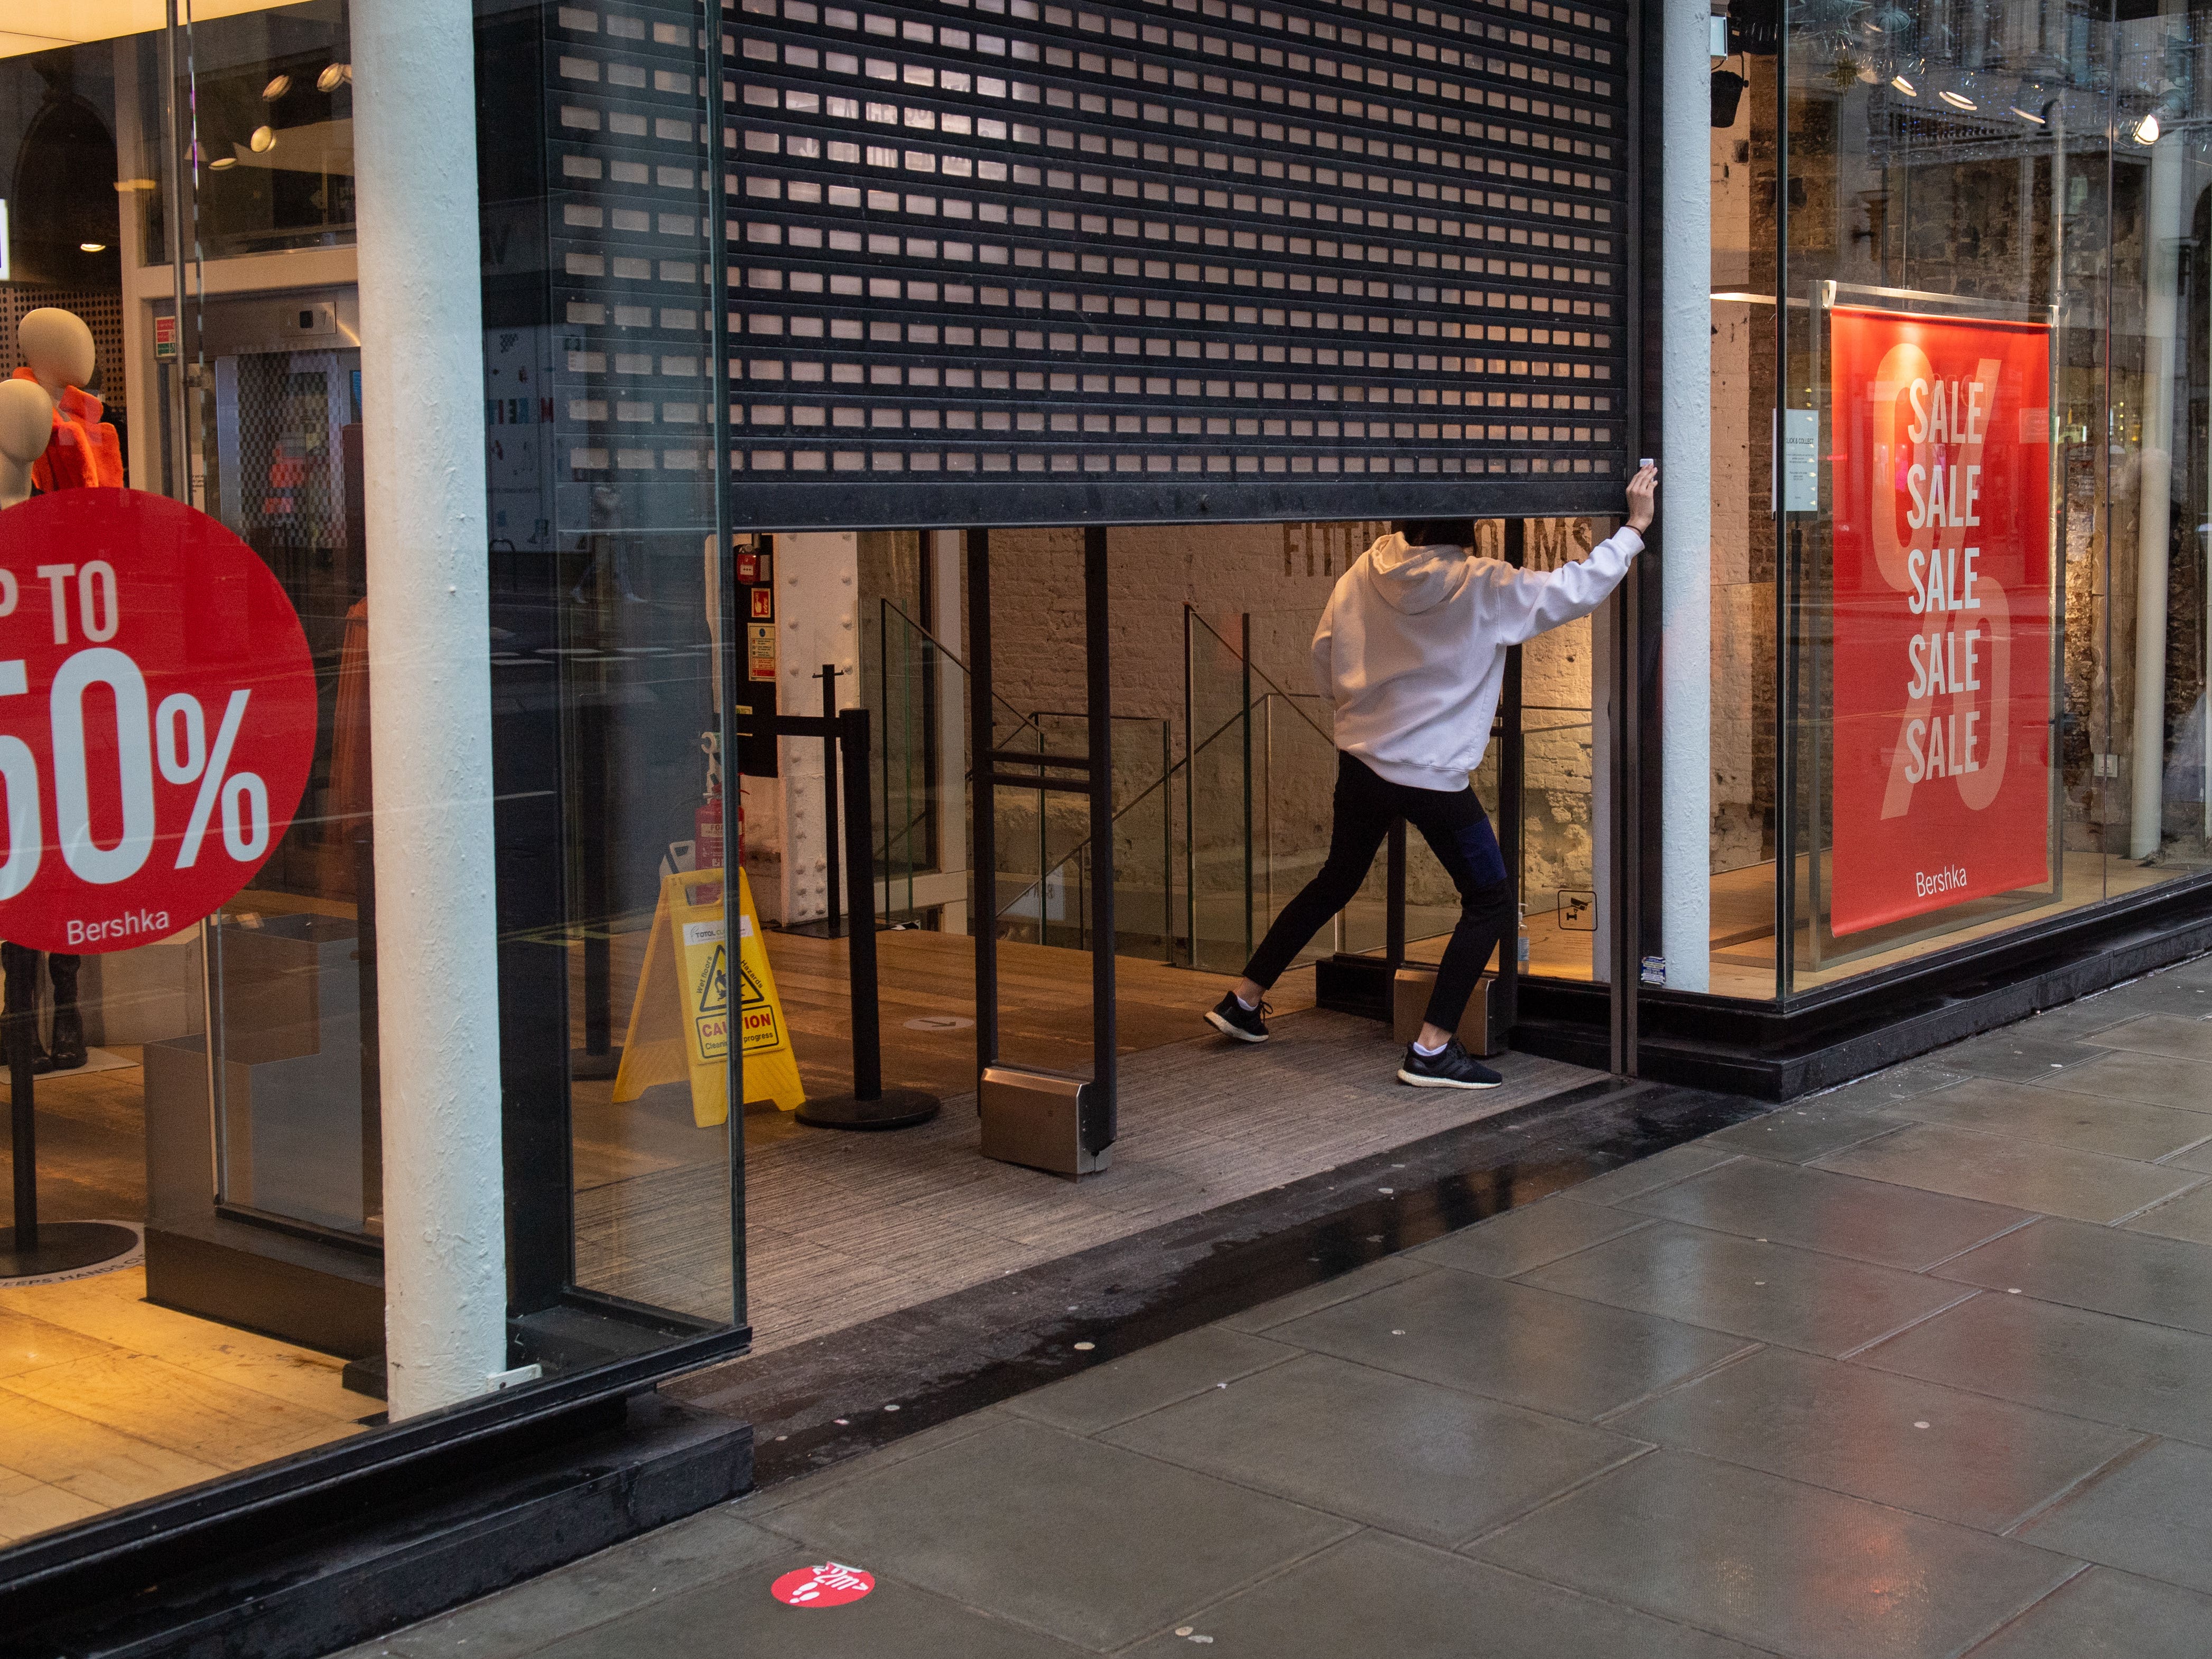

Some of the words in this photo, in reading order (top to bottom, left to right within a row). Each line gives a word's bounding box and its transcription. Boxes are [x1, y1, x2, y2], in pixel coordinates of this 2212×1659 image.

[1908, 378, 1983, 444] SALE
[1907, 464, 1980, 529] SALE
[1908, 548, 1981, 614] SALE
[38, 561, 118, 644] TO
[1908, 629, 1981, 699] SALE
[1904, 711, 1980, 784] SALE
[1916, 864, 1967, 897] Bershka
[67, 909, 169, 945] Bershka
[696, 980, 705, 994] Wet
[704, 956, 712, 978] floors
[740, 959, 764, 988] Hazards
[702, 1013, 771, 1037] CAUION
[743, 1032, 773, 1043] progress
[59, 1264, 125, 1281] HANDS
